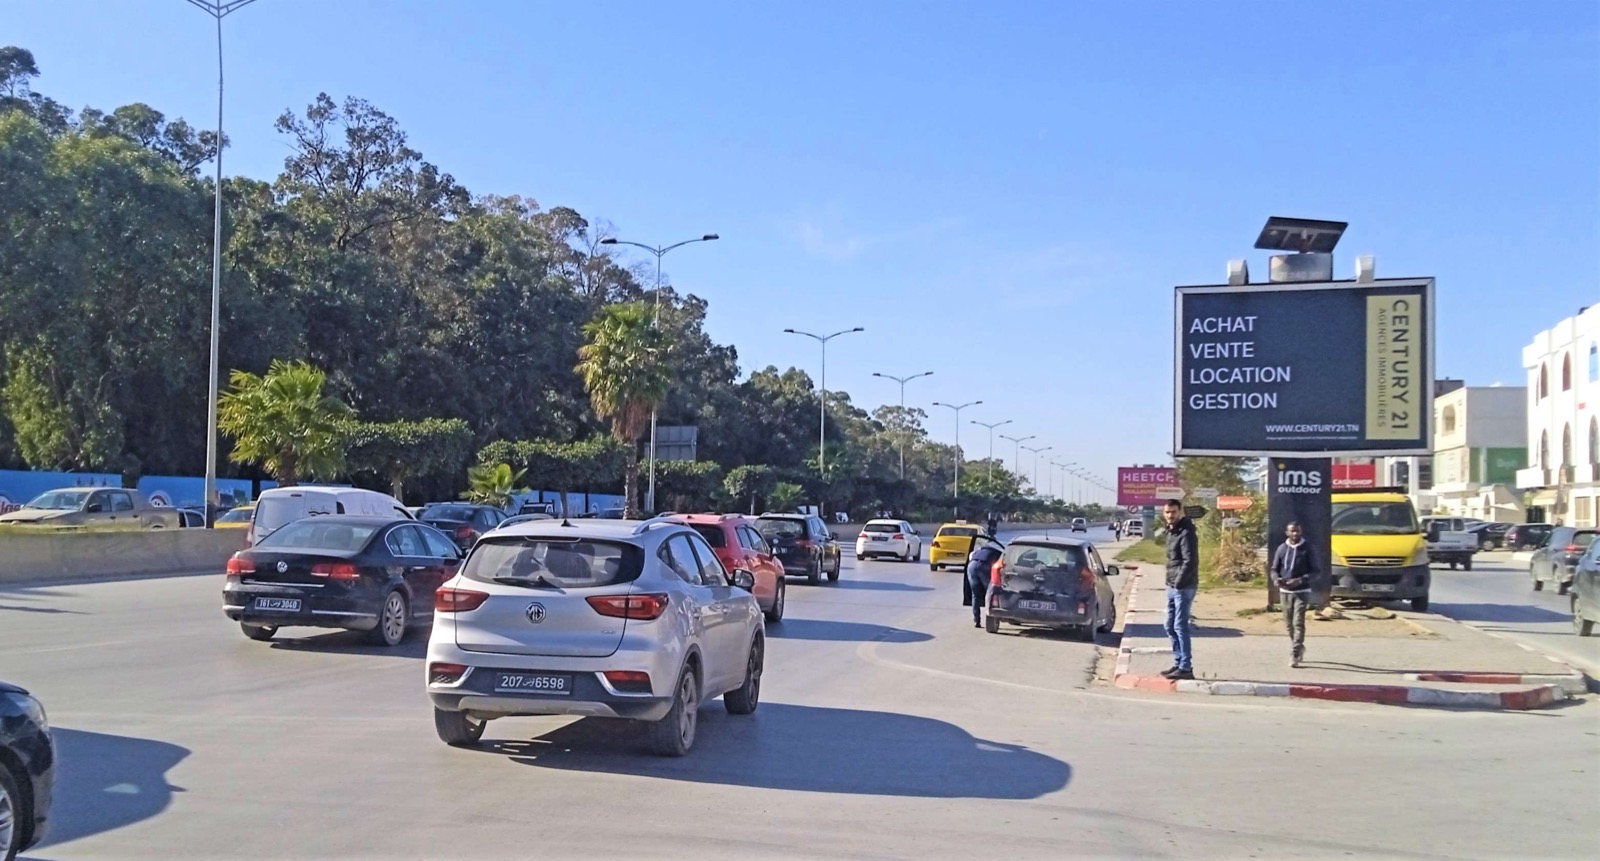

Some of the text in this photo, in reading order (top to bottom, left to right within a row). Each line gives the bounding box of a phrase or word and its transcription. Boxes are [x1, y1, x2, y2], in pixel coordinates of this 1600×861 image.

[1190, 316, 1257, 334] ACHAT
[1190, 341, 1255, 359] VENTE
[1377, 308, 1387, 428] AGENCES IMMOBILIÈRES
[1391, 299, 1409, 429] CENTURY 21
[1190, 366, 1291, 385] LOCATION
[1189, 392, 1278, 410] GESTION
[1265, 424, 1360, 433] WWW.CENTURY21.TN
[1278, 463, 1322, 486] ims
[1278, 486, 1322, 494] outdoor
[260, 599, 270, 608] 161
[281, 600, 297, 609] 3040
[501, 675, 523, 688] 207
[535, 677, 564, 690] 6598
